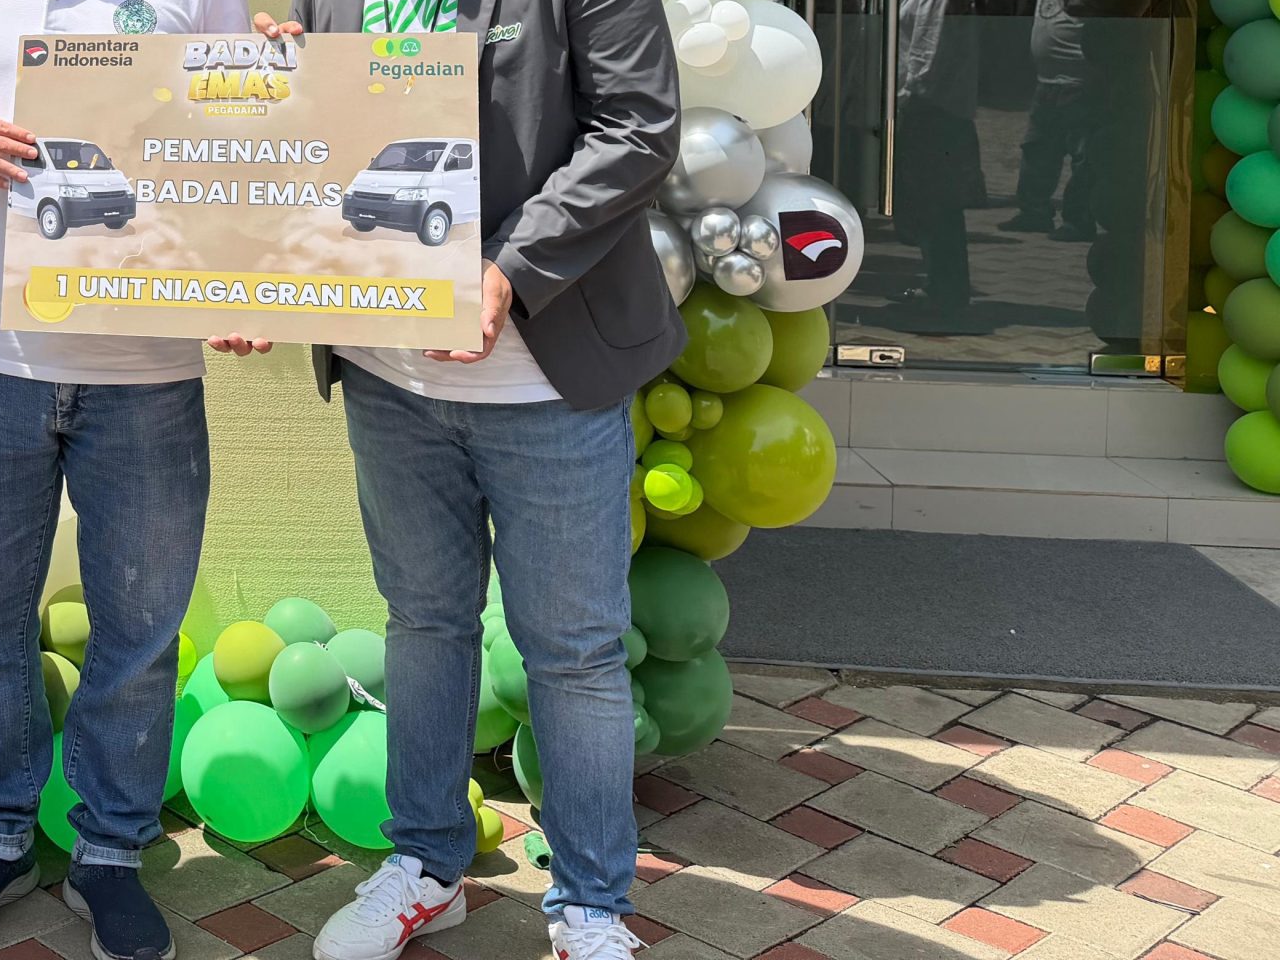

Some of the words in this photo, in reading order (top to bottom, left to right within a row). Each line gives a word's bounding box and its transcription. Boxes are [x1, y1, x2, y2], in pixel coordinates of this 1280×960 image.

[55, 39, 139, 52] Danantara
[183, 40, 297, 71] BADAI
[53, 53, 133, 67] Indonesia
[370, 61, 464, 79] Pegadaian
[187, 69, 291, 103] EMAS
[208, 106, 265, 115] PEGADAIAN
[143, 138, 330, 163] PEMENANG
[136, 179, 238, 205] BADAI
[248, 181, 343, 207] EMAS
[55, 274, 68, 298] 1
[78, 276, 147, 301] UNIT
[152, 278, 250, 304] NIAGA
[255, 281, 348, 307] GRAN
[351, 284, 427, 311] MAX
